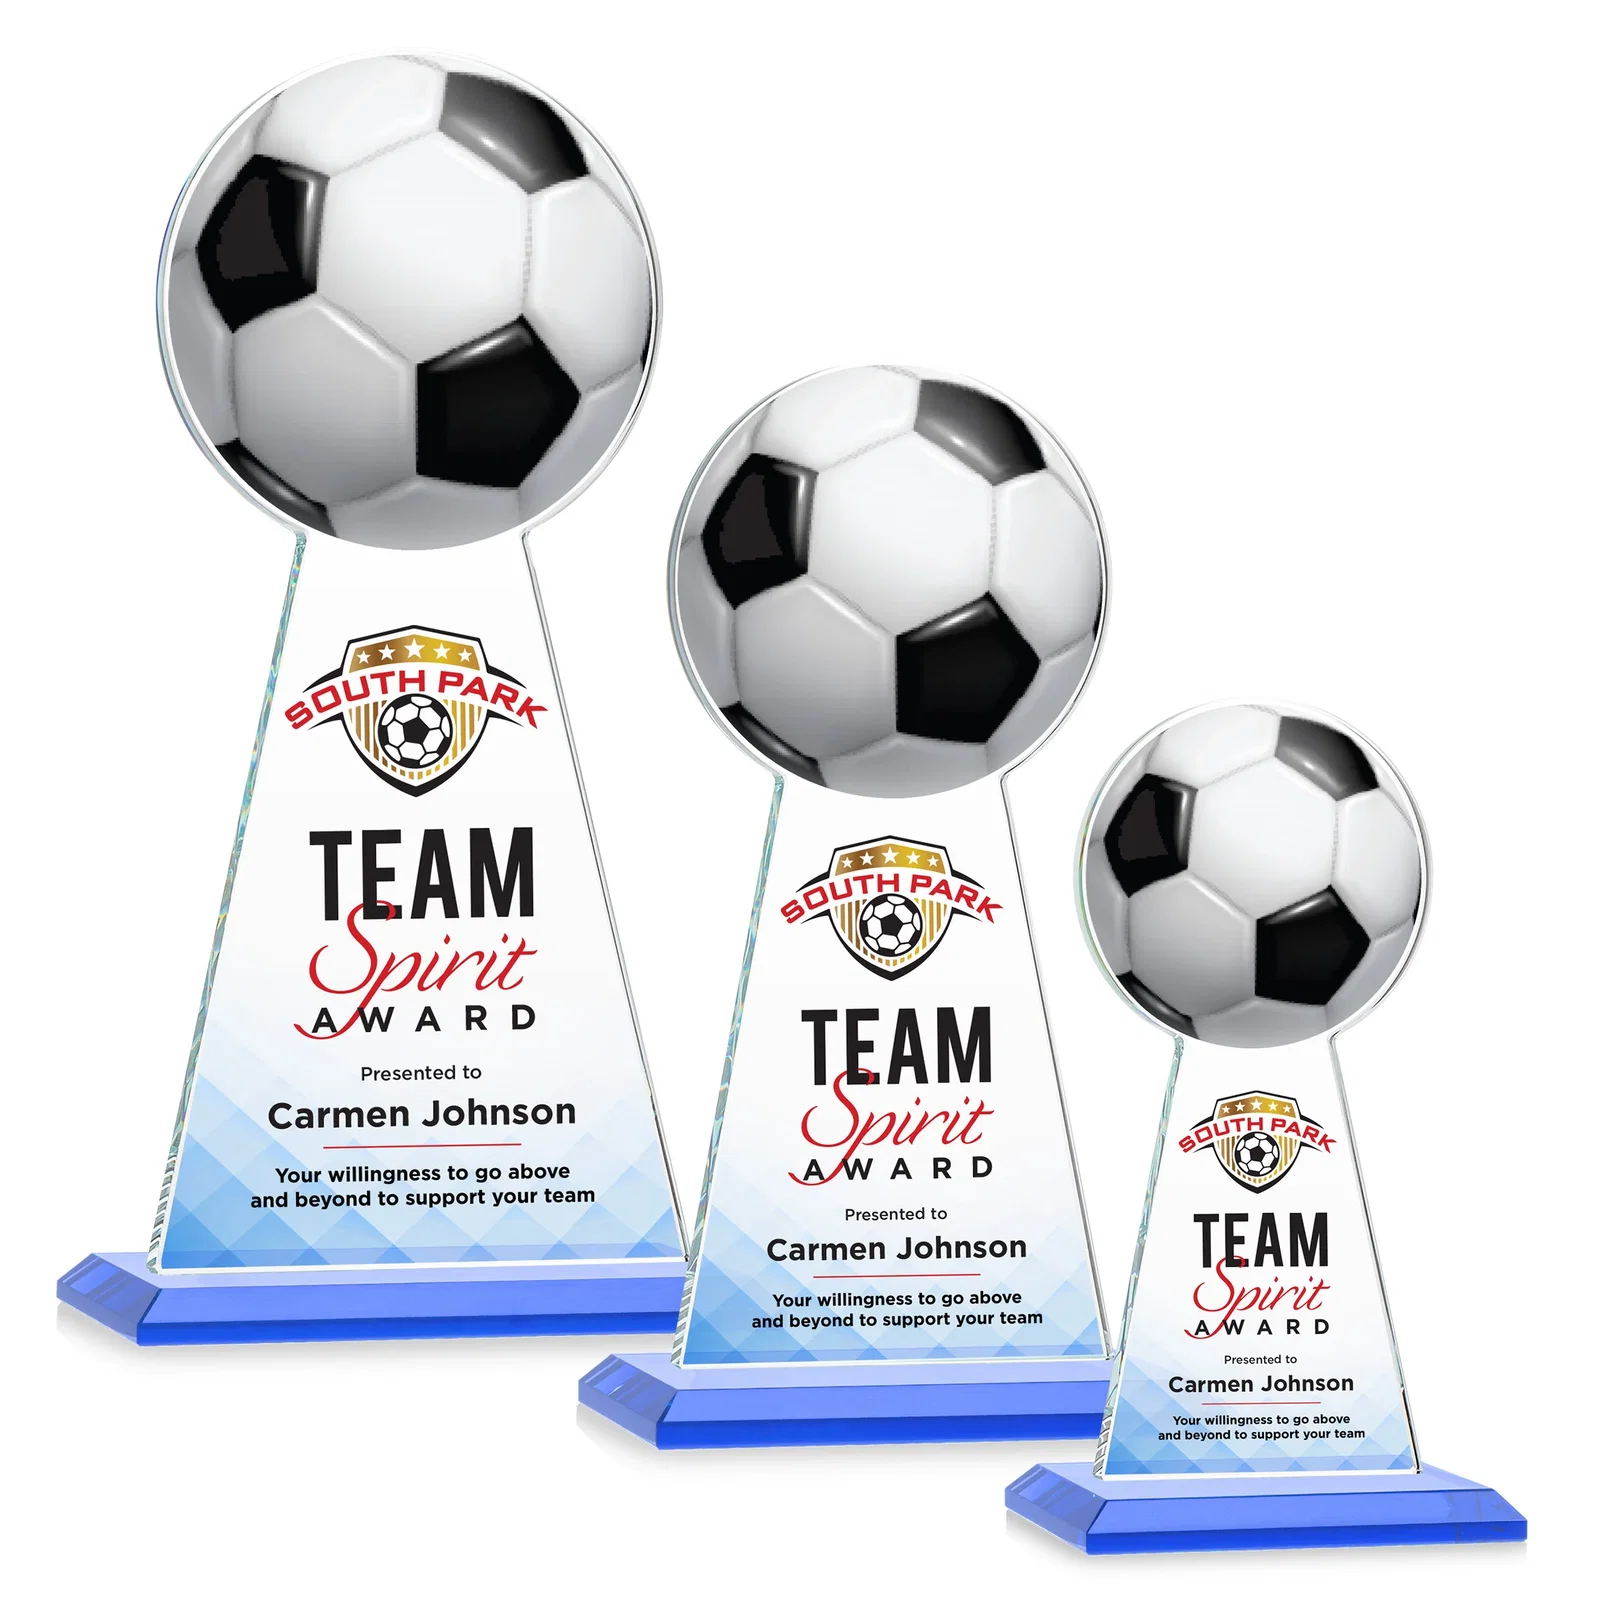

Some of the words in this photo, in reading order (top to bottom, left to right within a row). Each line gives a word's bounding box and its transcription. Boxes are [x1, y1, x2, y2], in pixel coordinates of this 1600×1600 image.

[284, 669, 426, 730] SOUTH
[437, 670, 548, 729] PARK
[309, 826, 534, 921] TEAM
[780, 873, 900, 925] SOUTH
[909, 873, 1003, 923] PARK
[293, 899, 537, 1041] Spirit
[311, 1004, 536, 1034] AWARD
[801, 1006, 992, 1086] TEAM
[361, 1064, 456, 1082] Presented
[462, 1065, 482, 1080] to
[268, 1102, 410, 1130] Carmen
[421, 1097, 576, 1127] Johnson
[787, 1067, 994, 1187] Spirit
[1178, 1116, 1264, 1153] SOUTH
[1270, 1117, 1337, 1153] PARK
[275, 1167, 322, 1184] Your
[327, 1165, 441, 1185] willingness
[447, 1165, 469, 1181] to
[475, 1167, 502, 1184] go
[508, 1163, 571, 1180] above
[802, 1155, 993, 1181] AWARD
[250, 1191, 288, 1209] and
[295, 1190, 371, 1210] beyond
[377, 1191, 399, 1206] to
[405, 1189, 486, 1209] support
[491, 1191, 538, 1207] your
[543, 1188, 595, 1204] team
[845, 1206, 925, 1221] Presented
[930, 1207, 948, 1220] to
[766, 1238, 886, 1262] Carmen
[896, 1235, 1027, 1260] Johnson
[1193, 1212, 1329, 1269] TEAM
[772, 1294, 812, 1308] Your
[817, 1292, 913, 1309] willingness
[917, 1292, 936, 1305] to
[941, 1293, 964, 1308] go
[969, 1290, 1022, 1305] above
[1183, 1255, 1330, 1339] Spirit
[751, 1314, 784, 1329] and
[789, 1313, 854, 1330] beyond
[859, 1313, 878, 1327] to
[882, 1312, 951, 1329] support
[955, 1314, 995, 1328] your
[999, 1311, 1043, 1325] team
[1194, 1318, 1330, 1336] AWARD
[1224, 1354, 1282, 1365] Presented
[1285, 1355, 1298, 1364] to
[1168, 1376, 1254, 1393] Carmen
[1261, 1374, 1354, 1392] Johnson
[1172, 1415, 1202, 1426] Your
[1204, 1414, 1273, 1427] willingness
[1276, 1415, 1290, 1425] to
[1292, 1416, 1310, 1427] go
[1312, 1413, 1351, 1424] above
[1158, 1430, 1181, 1441] and
[1184, 1429, 1231, 1442] beyond
[1234, 1430, 1248, 1440] to
[1251, 1429, 1300, 1441] support
[1303, 1430, 1331, 1441] your
[1334, 1428, 1365, 1439] team
